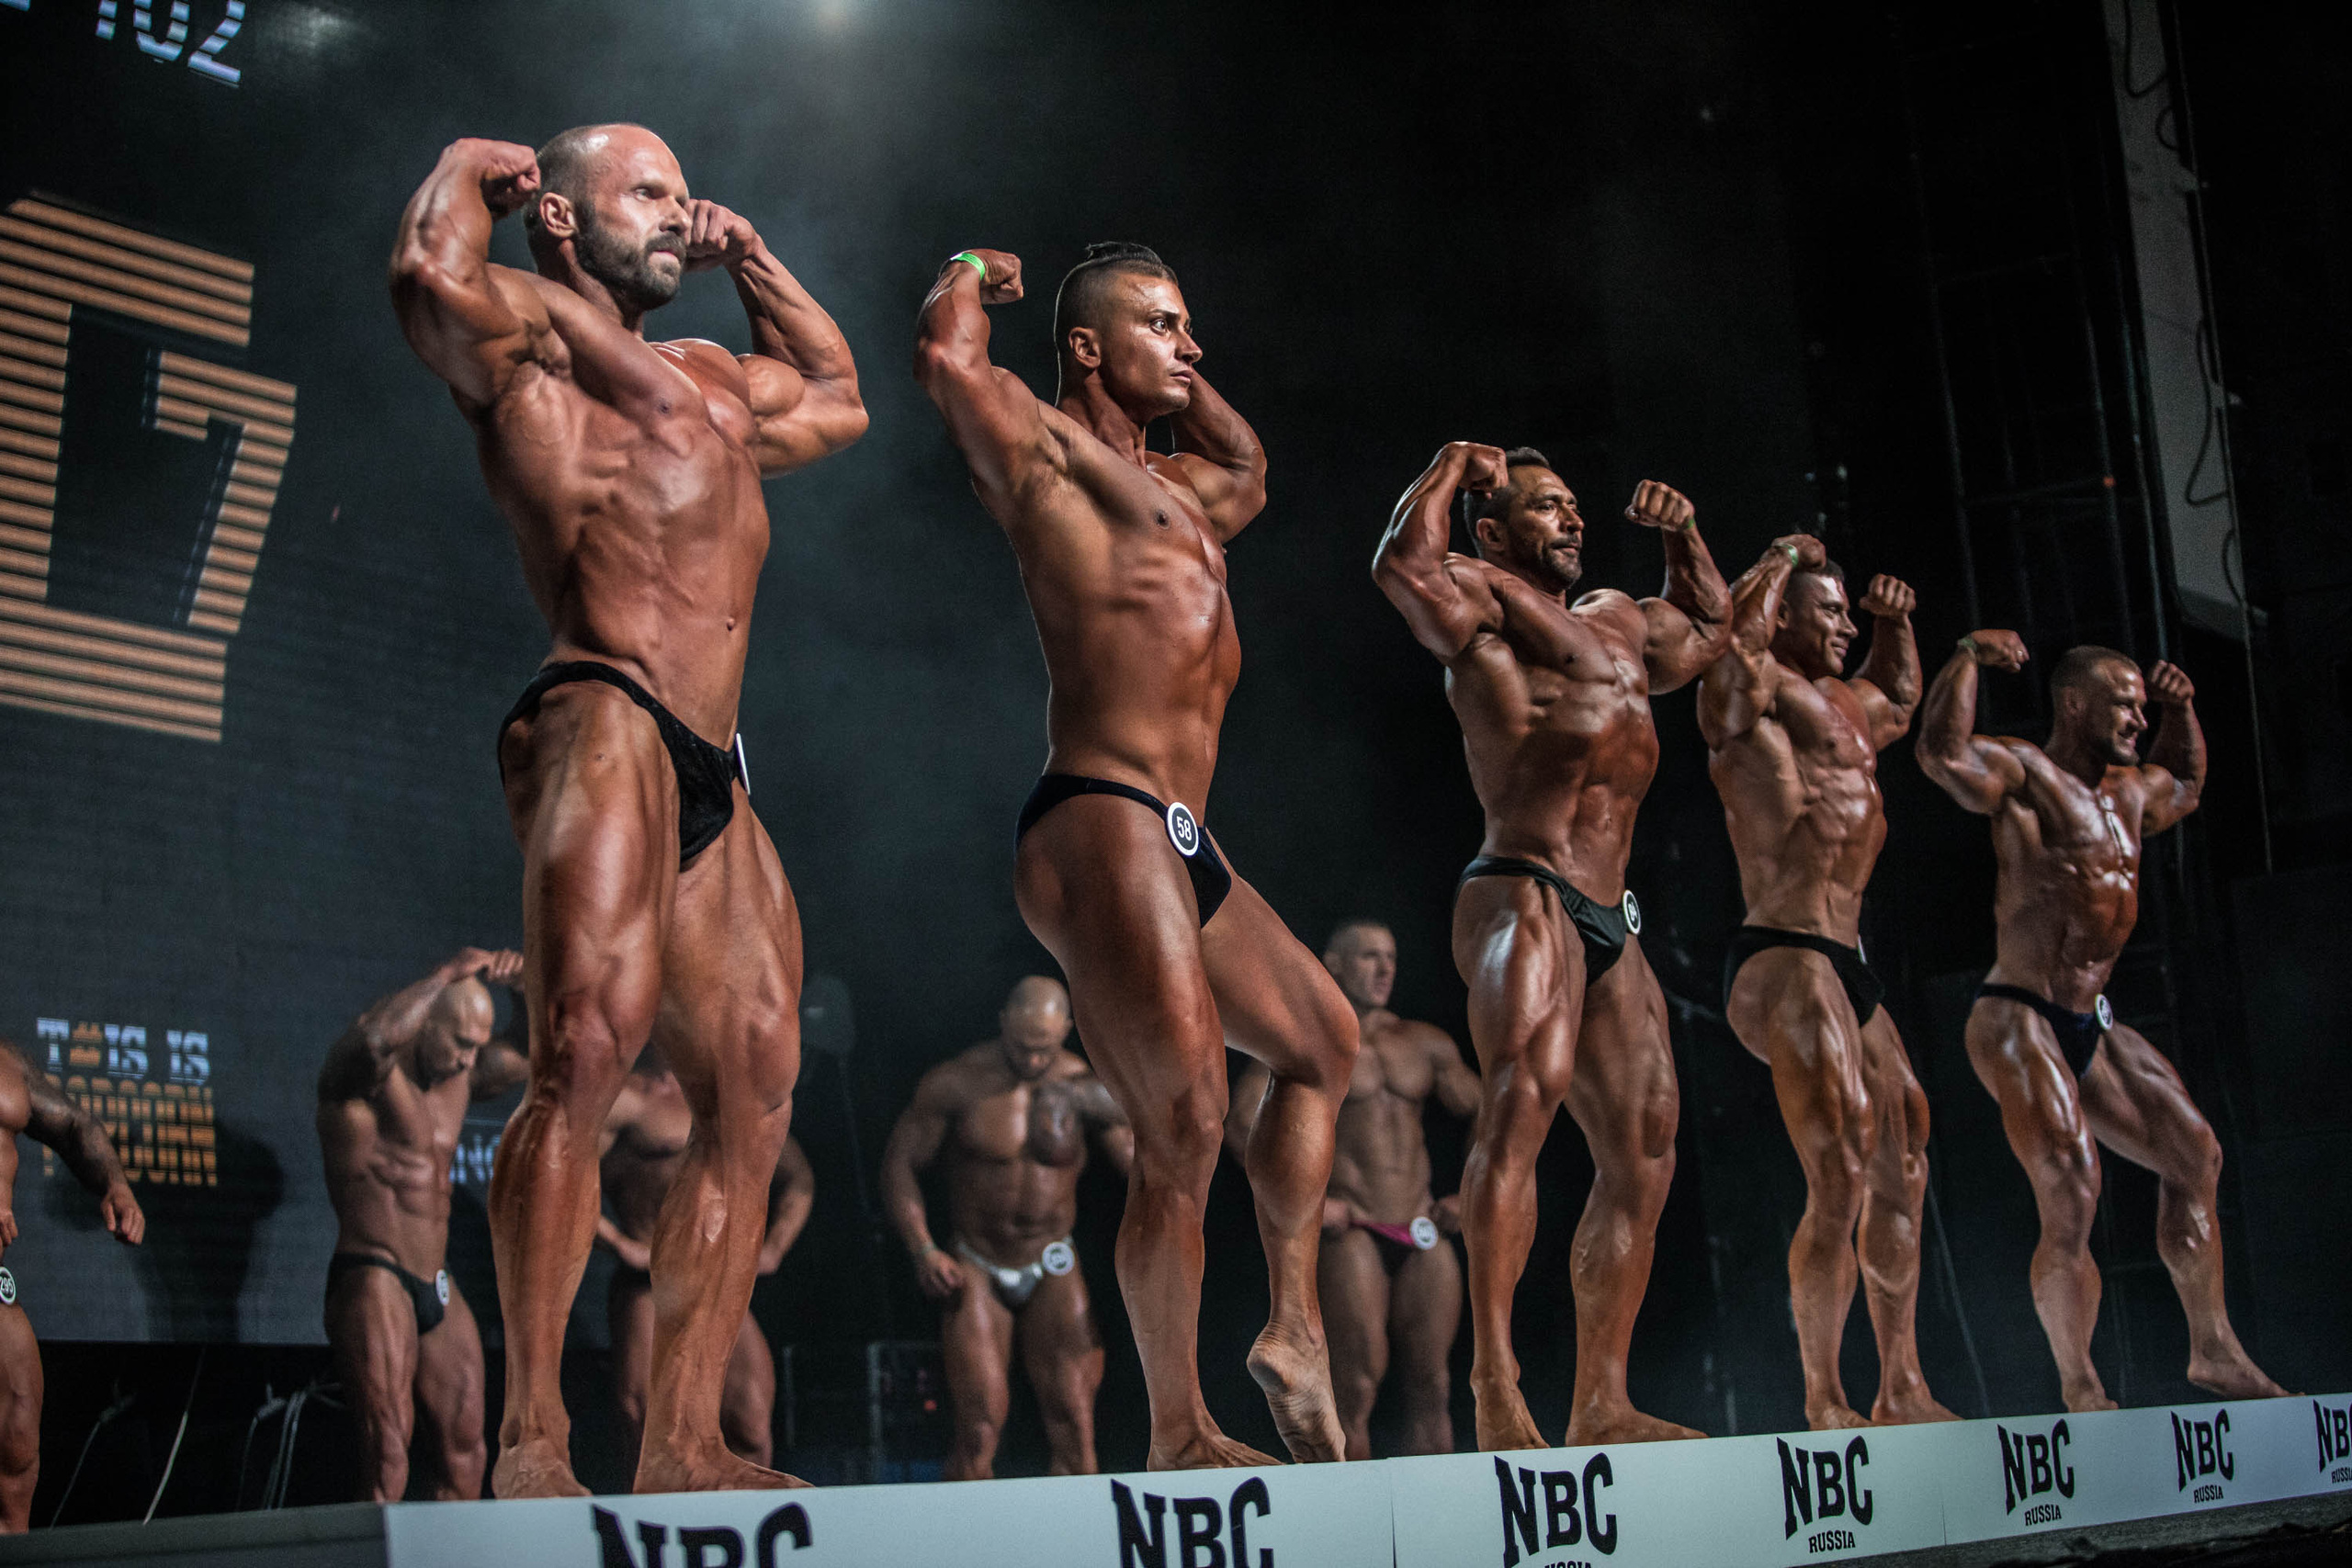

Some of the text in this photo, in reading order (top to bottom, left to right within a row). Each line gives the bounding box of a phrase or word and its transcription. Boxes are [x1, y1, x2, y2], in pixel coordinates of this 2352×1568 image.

[1176, 815, 1193, 841] 58
[166, 1029, 210, 1086] IS
[2171, 1408, 2233, 1493] NBC
[2312, 1398, 2352, 1473] NB
[1776, 1435, 1873, 1540] NBC
[1997, 1418, 2075, 1516] NBC
[2193, 1483, 2223, 1504] RUSSIA
[2331, 1467, 2352, 1484] RUSSI
[1494, 1451, 1618, 1568] NBC
[2024, 1504, 2062, 1527] RUSSIA
[1808, 1529, 1856, 1553] RUSSIA
